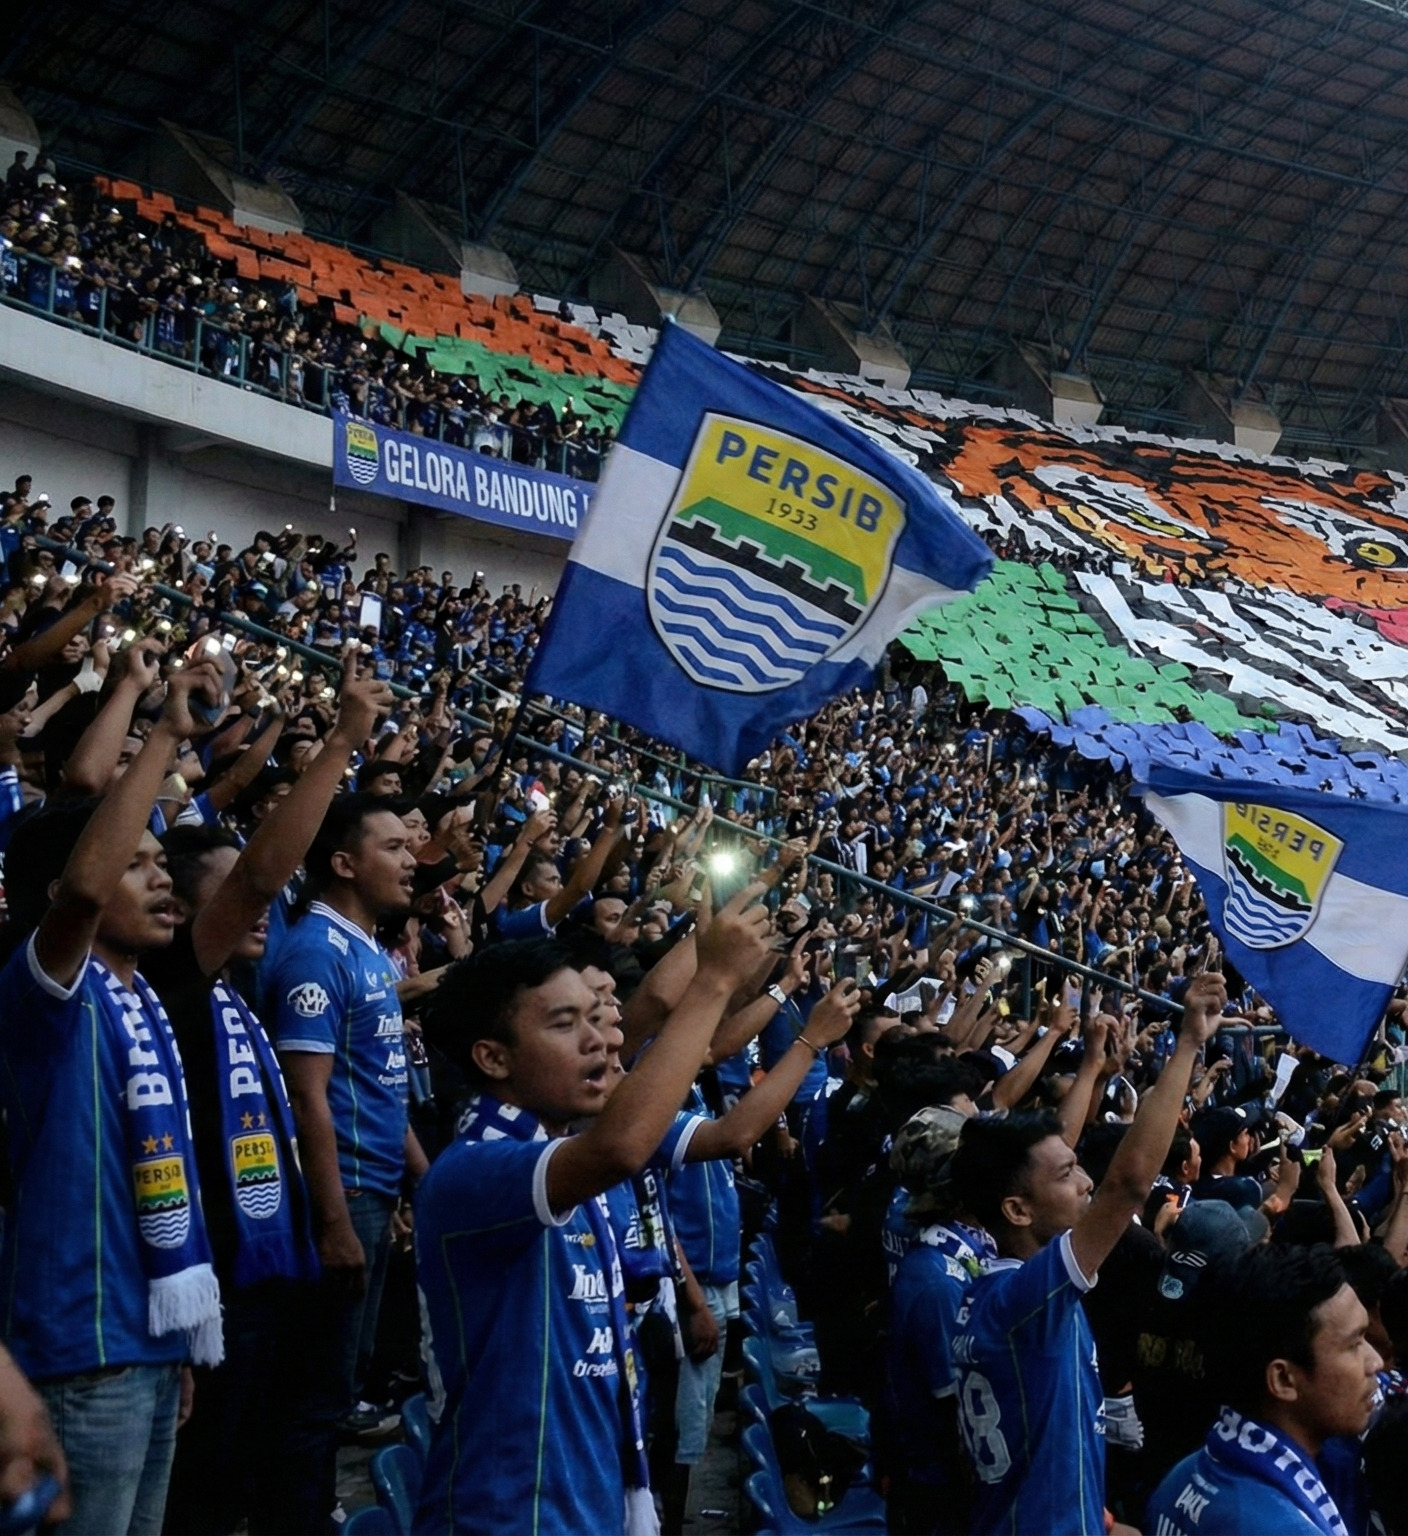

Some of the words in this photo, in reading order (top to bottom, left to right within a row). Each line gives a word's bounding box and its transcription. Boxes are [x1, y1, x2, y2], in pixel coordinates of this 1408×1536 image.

[384, 439, 470, 502] GELORA
[474, 466, 578, 528] BANDUNG
[715, 430, 884, 533] PERSIB
